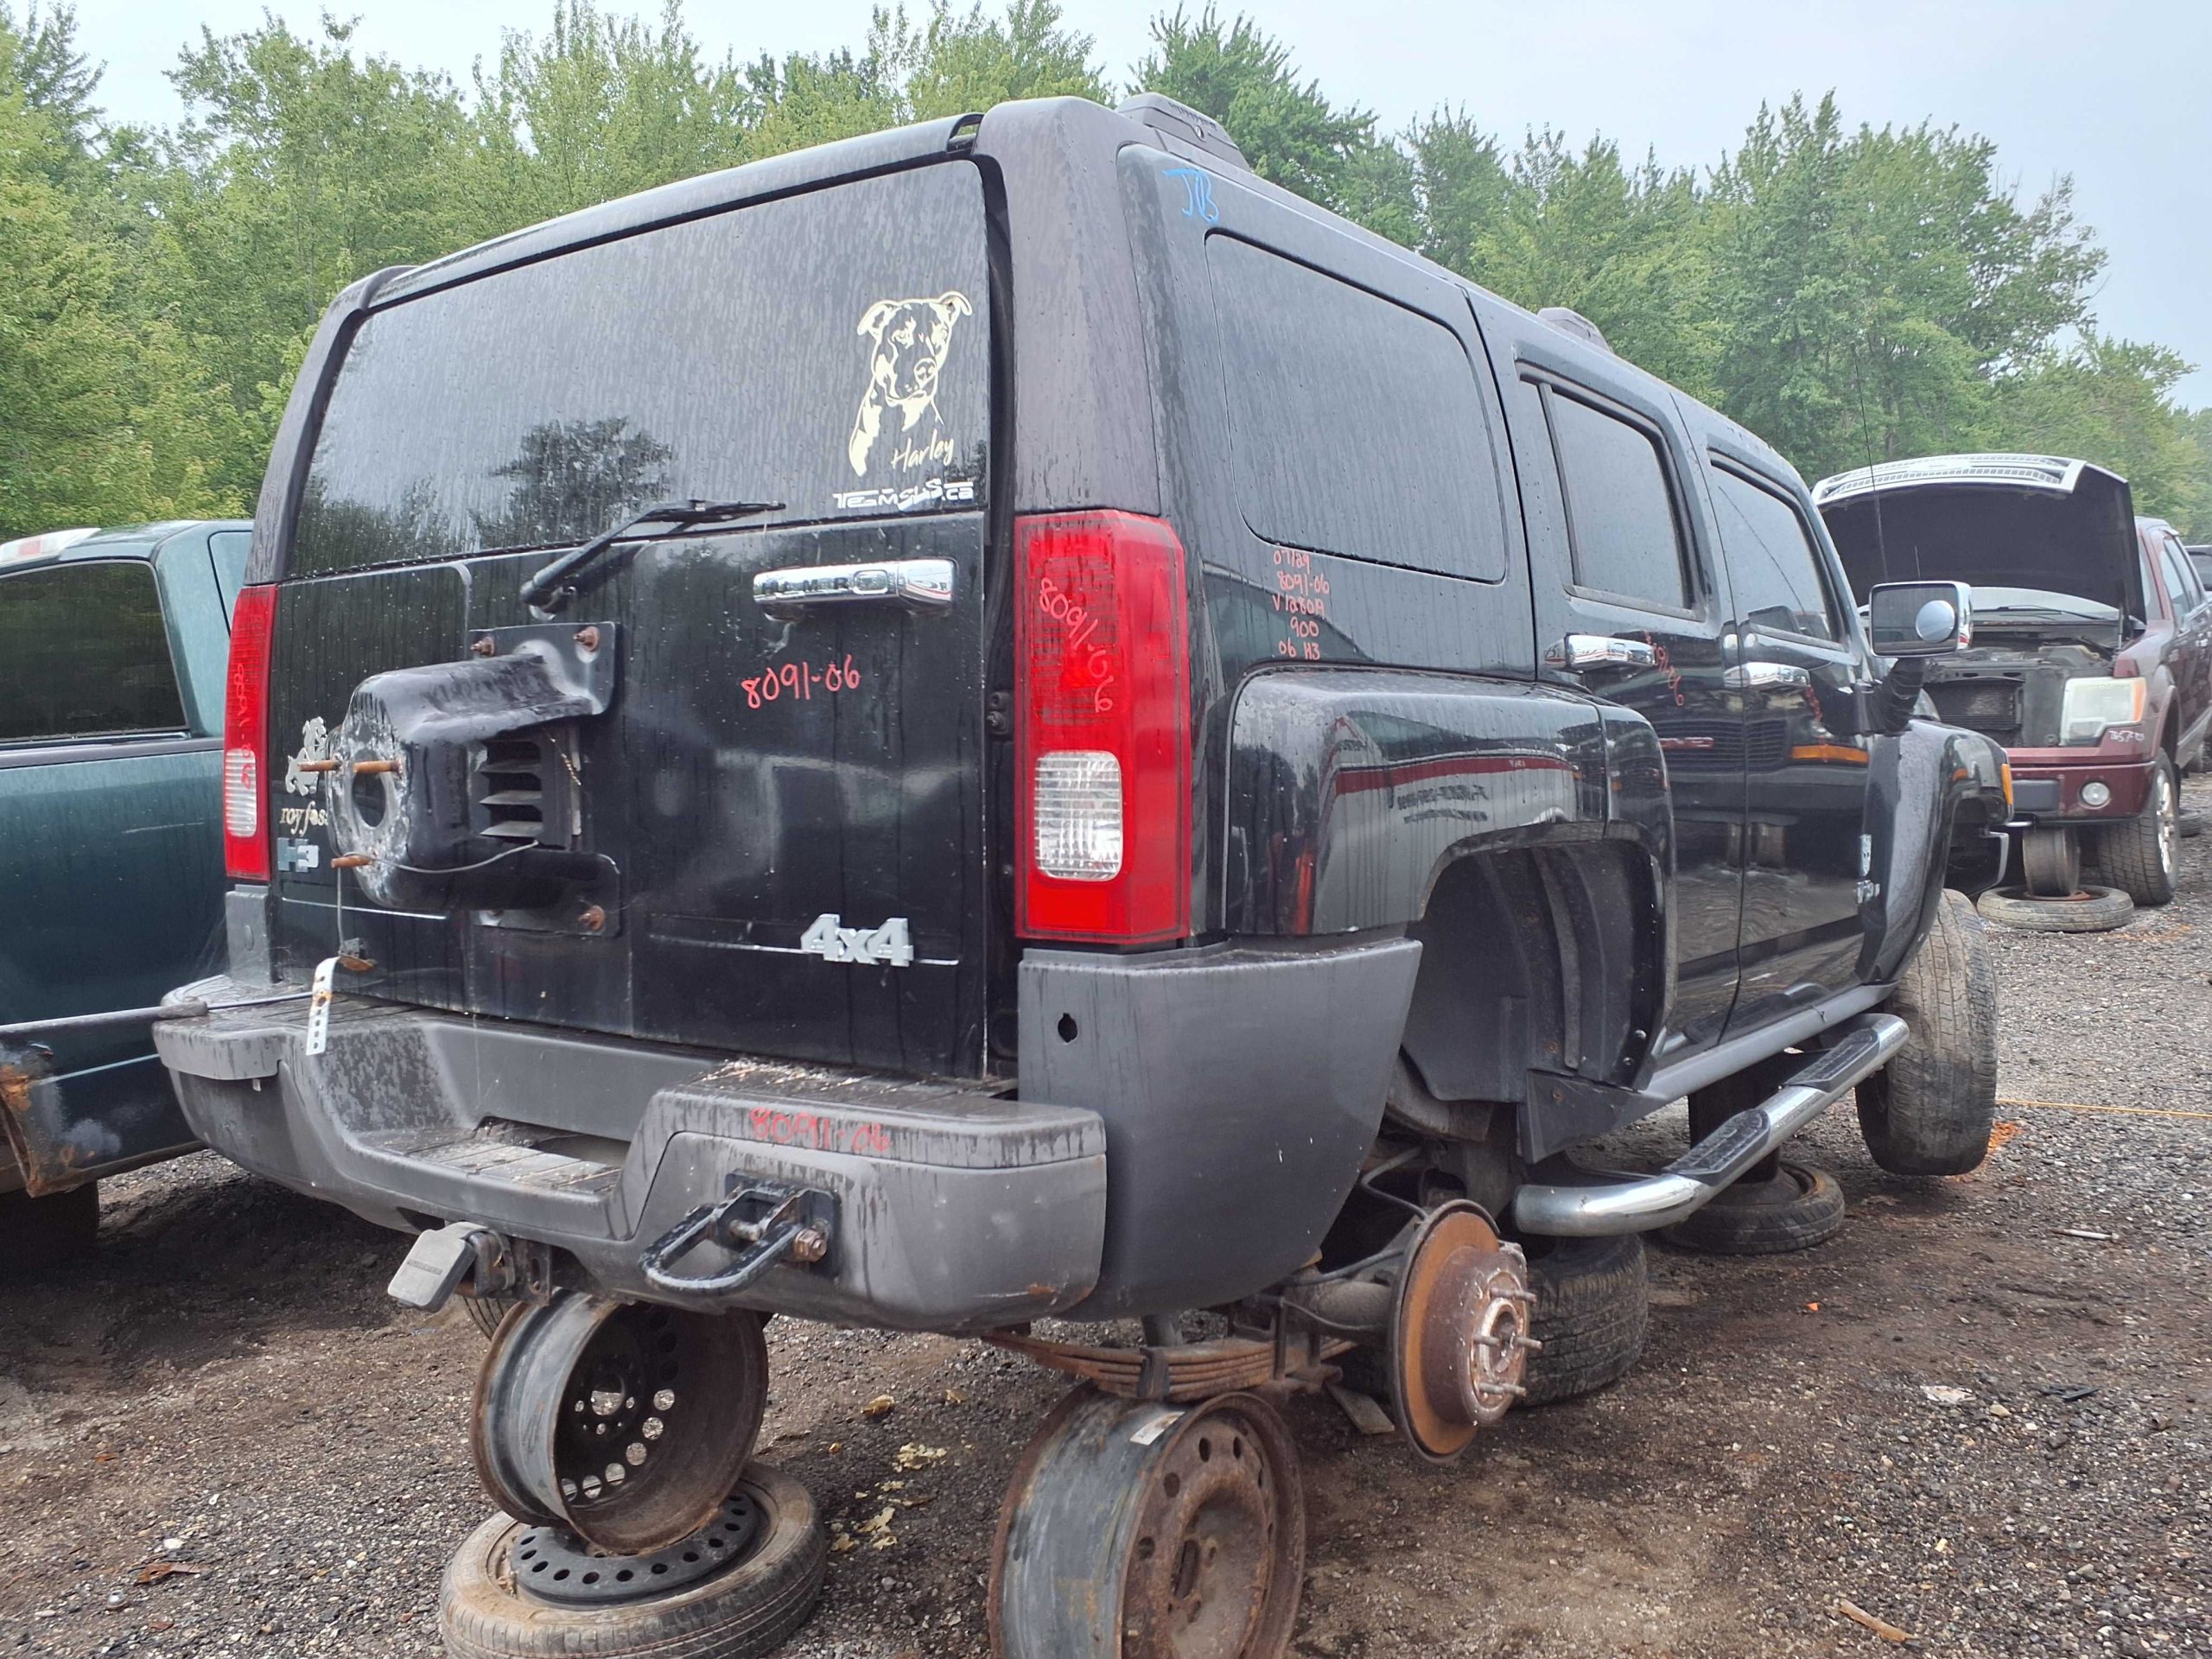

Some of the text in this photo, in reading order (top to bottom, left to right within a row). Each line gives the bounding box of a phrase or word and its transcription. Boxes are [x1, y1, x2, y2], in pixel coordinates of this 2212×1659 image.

[891, 429, 954, 474] Harley
[1279, 638, 1297, 658] 06
[1290, 616, 1319, 638] 900
[741, 654, 861, 709] 8091-06
[800, 912, 914, 967] 4x4
[749, 1107, 891, 1153] 8091-06
